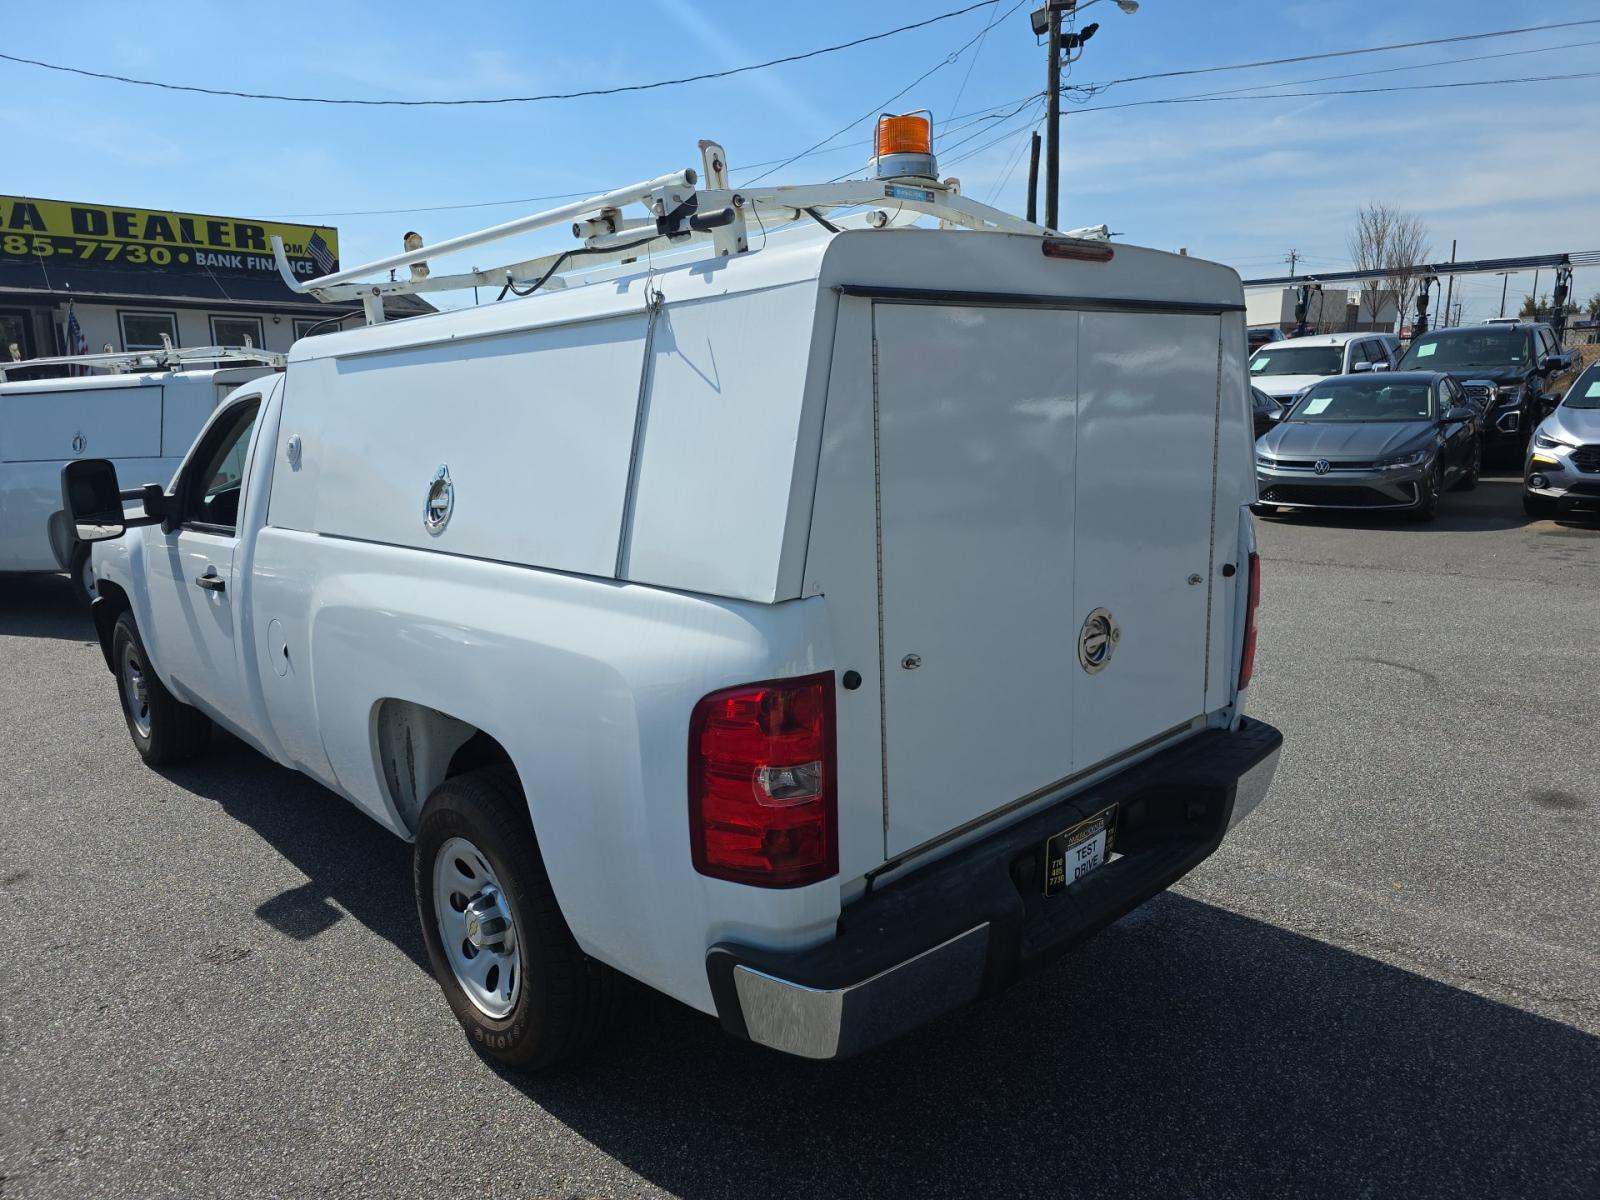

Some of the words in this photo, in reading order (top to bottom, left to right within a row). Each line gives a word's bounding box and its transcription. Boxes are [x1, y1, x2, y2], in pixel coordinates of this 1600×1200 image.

[0, 235, 171, 265] 85-7730
[196, 251, 242, 269] BANK
[1076, 839, 1098, 861] TEST
[1074, 855, 1098, 880] DRIVE
[1050, 875, 1064, 885] 7730
